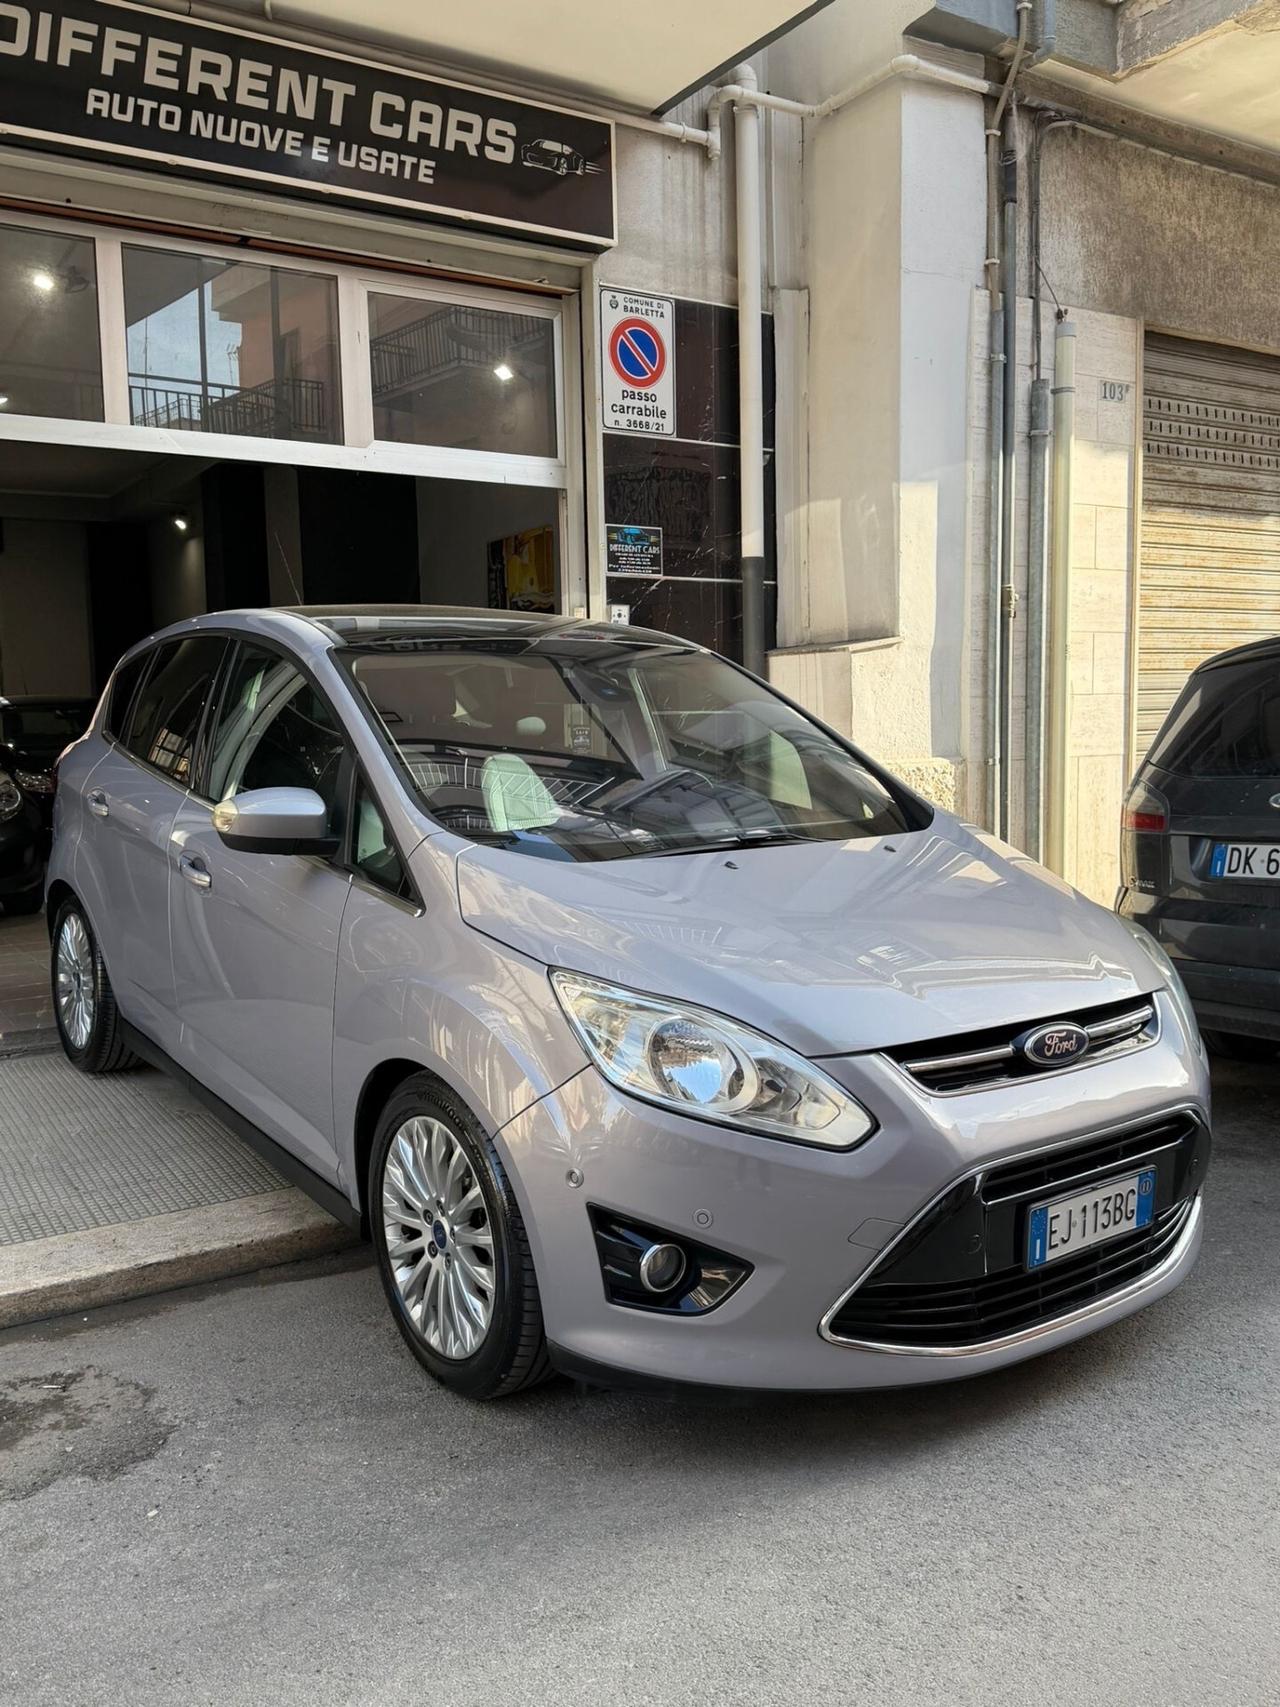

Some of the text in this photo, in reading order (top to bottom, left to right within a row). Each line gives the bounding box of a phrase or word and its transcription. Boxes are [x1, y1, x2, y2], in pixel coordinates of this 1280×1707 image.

[0, 2, 517, 164] DIFFERENT CARS
[86, 88, 436, 184] AUTO NUOVE E USATE
[623, 296, 654, 308] COMUNE
[623, 304, 665, 318] BARLETTA
[621, 389, 657, 403] passo
[611, 403, 667, 419] carrabile
[1044, 1031, 1079, 1057] Ford
